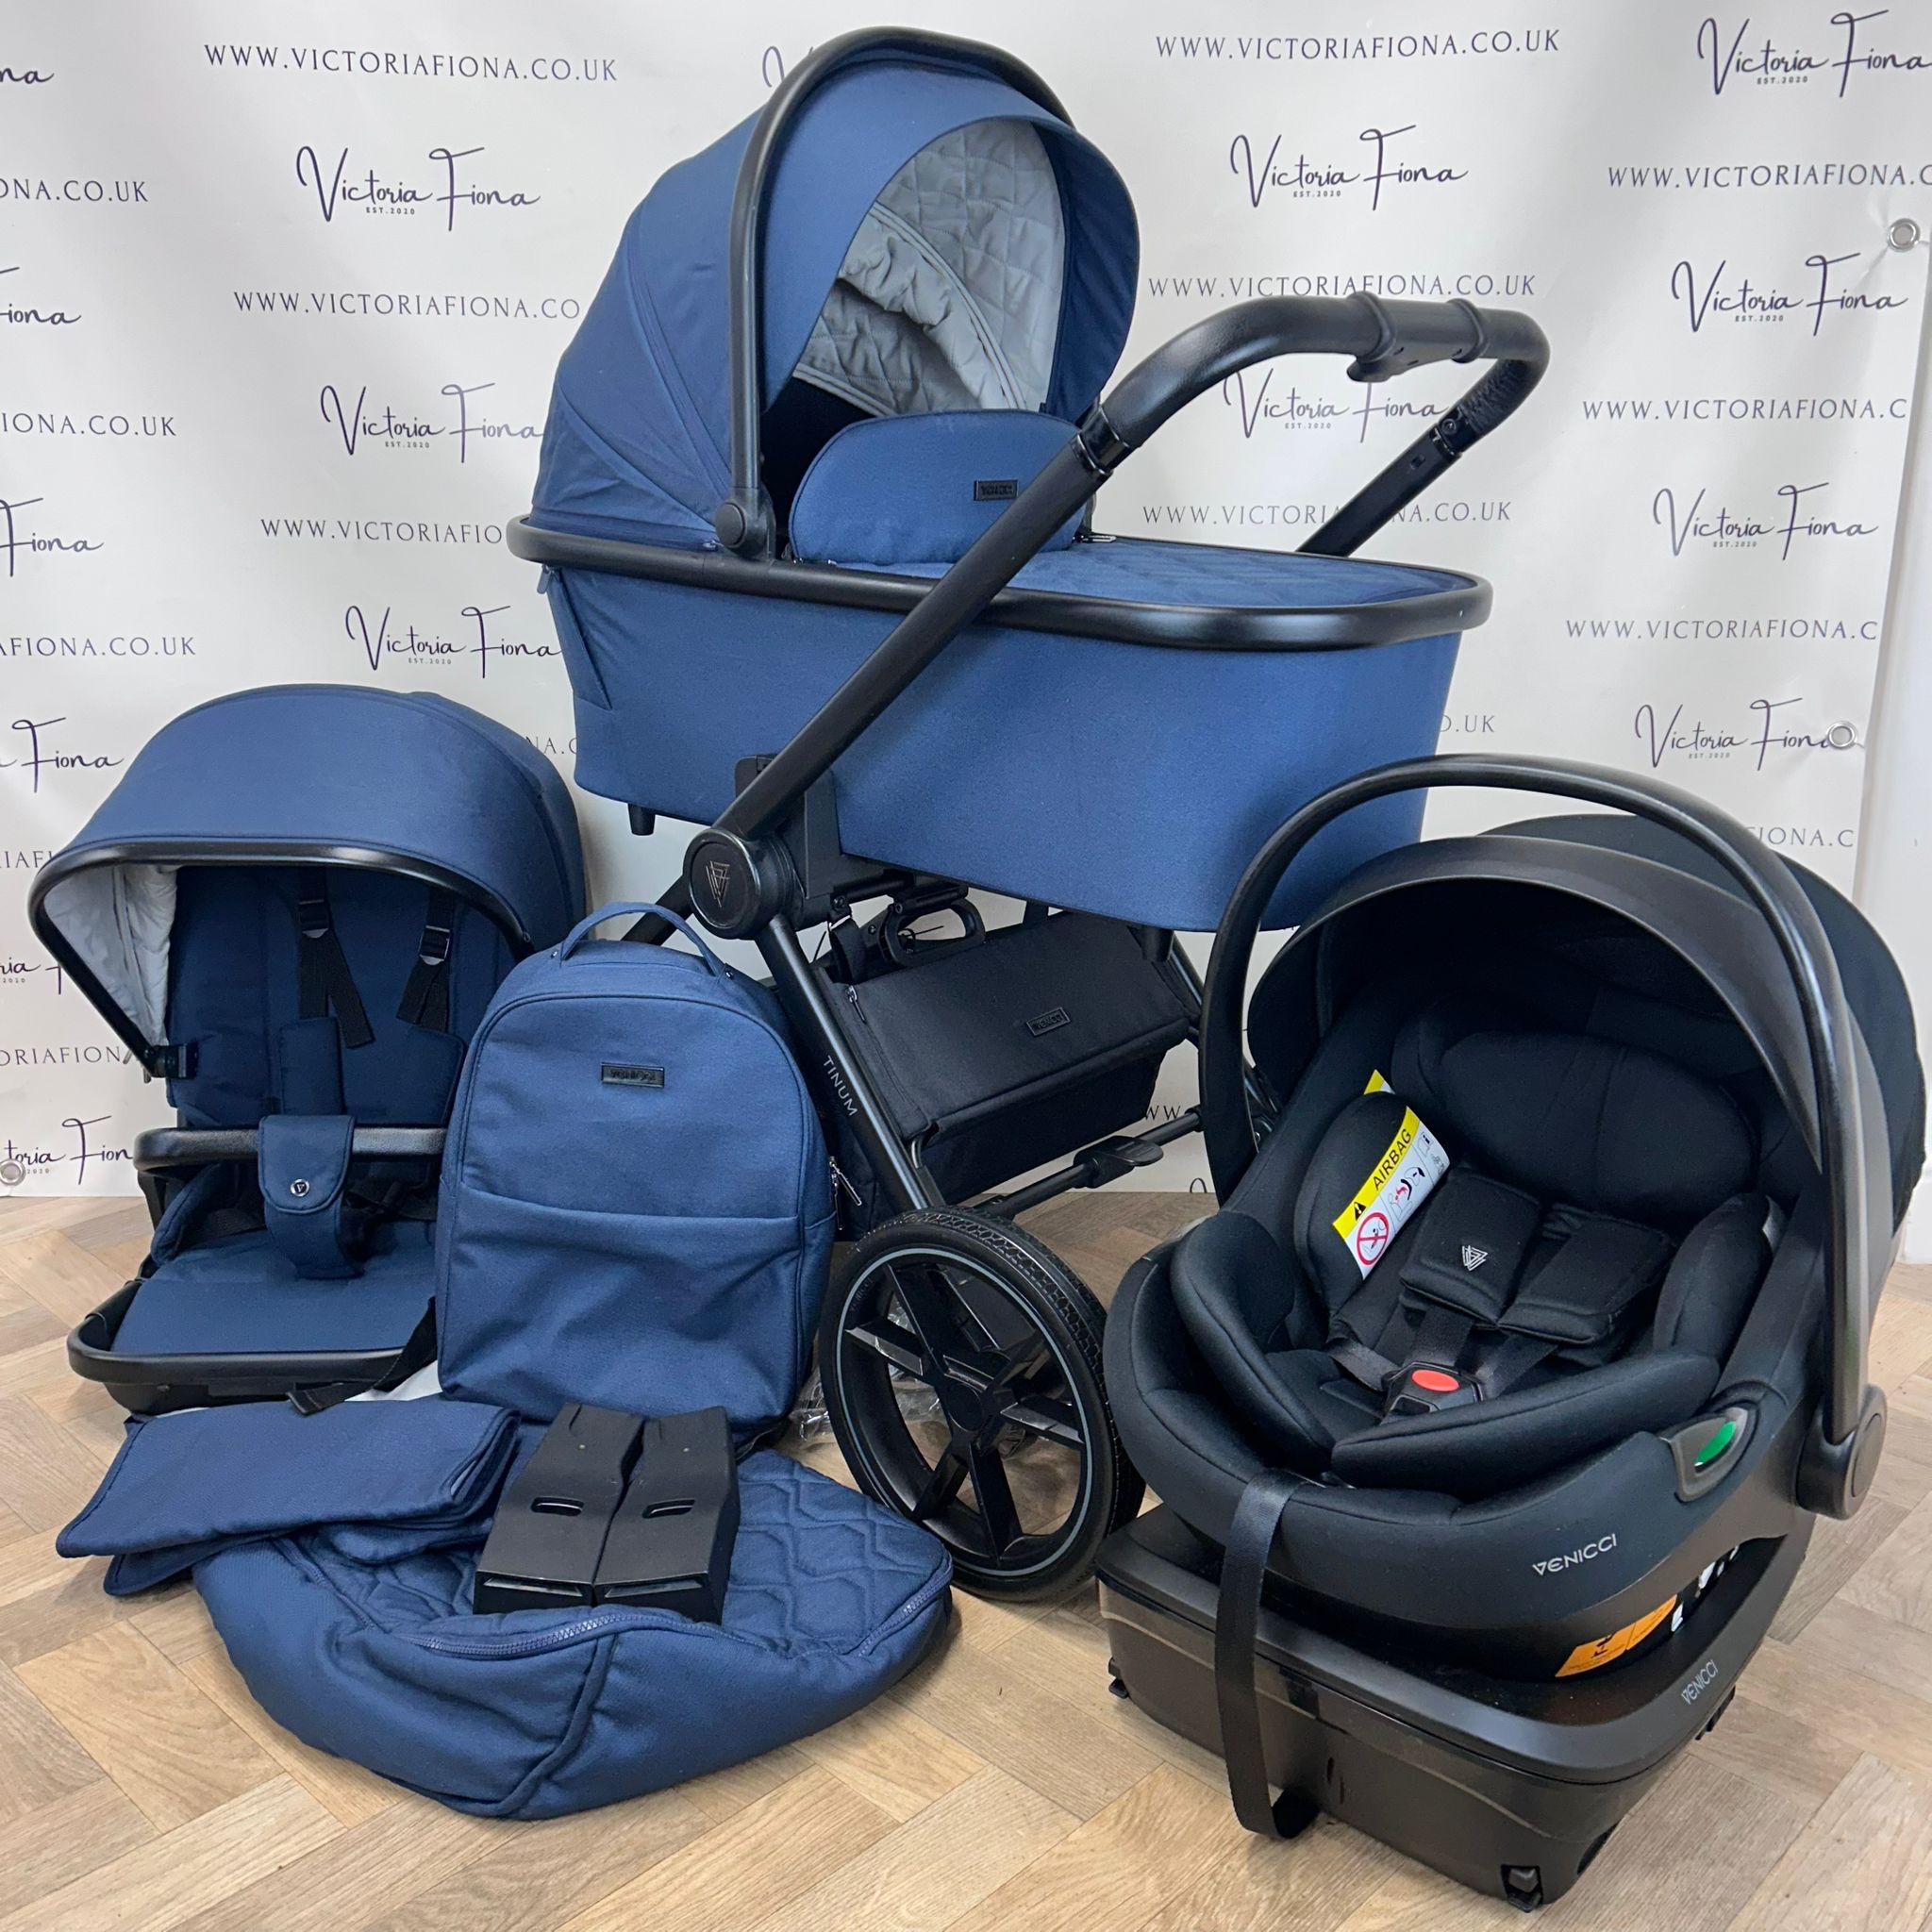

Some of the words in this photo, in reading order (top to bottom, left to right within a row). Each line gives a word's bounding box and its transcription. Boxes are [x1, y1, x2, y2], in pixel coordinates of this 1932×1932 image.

[204, 43, 618, 82] WWW.VICTORIAFIONA.CO.UK
[1155, 28, 1561, 60] WWW.VICTORIAFIONA.CO.UK
[1697, 17, 1829, 95] Victoria
[1830, 8, 1932, 98] Fiona
[295, 145, 434, 223] Victoria
[428, 146, 541, 232] Fiona
[1229, 134, 1360, 208] Victoria
[1359, 124, 1469, 212] Fiona
[233, 291, 581, 319] WWW.VICTORIAFIONA.CO
[1148, 274, 1537, 298] WWW.VICTORIAFIONA.CO.UK
[1671, 259, 1804, 333] Victoria
[1805, 252, 1908, 337] Fiona
[1, 412, 176, 437] IONA.CO.UK
[321, 385, 446, 456] Victoria
[441, 382, 545, 463] Fiona
[1224, 367, 1349, 439] Victoria
[1582, 398, 1907, 421] WWW.VICTORIAFIONA.C
[259, 518, 503, 544] WWW.VICTORIAFIO
[1653, 488, 1774, 557] Victoria
[1776, 481, 1879, 561] Fiona
[345, 605, 467, 672] Victoria
[460, 605, 563, 679] Fiona
[1566, 619, 1878, 641] WWW.VICTORIAFIONA.C
[12, 716, 125, 793] Fiona
[1635, 704, 1748, 768] Victoria
[824, 1055, 858, 1116] TINUM
[1373, 1128, 1412, 1191] AIRBAG
[1532, 1533, 1618, 1575] VENICCI
[1681, 1659, 1718, 1705] VENICCI
